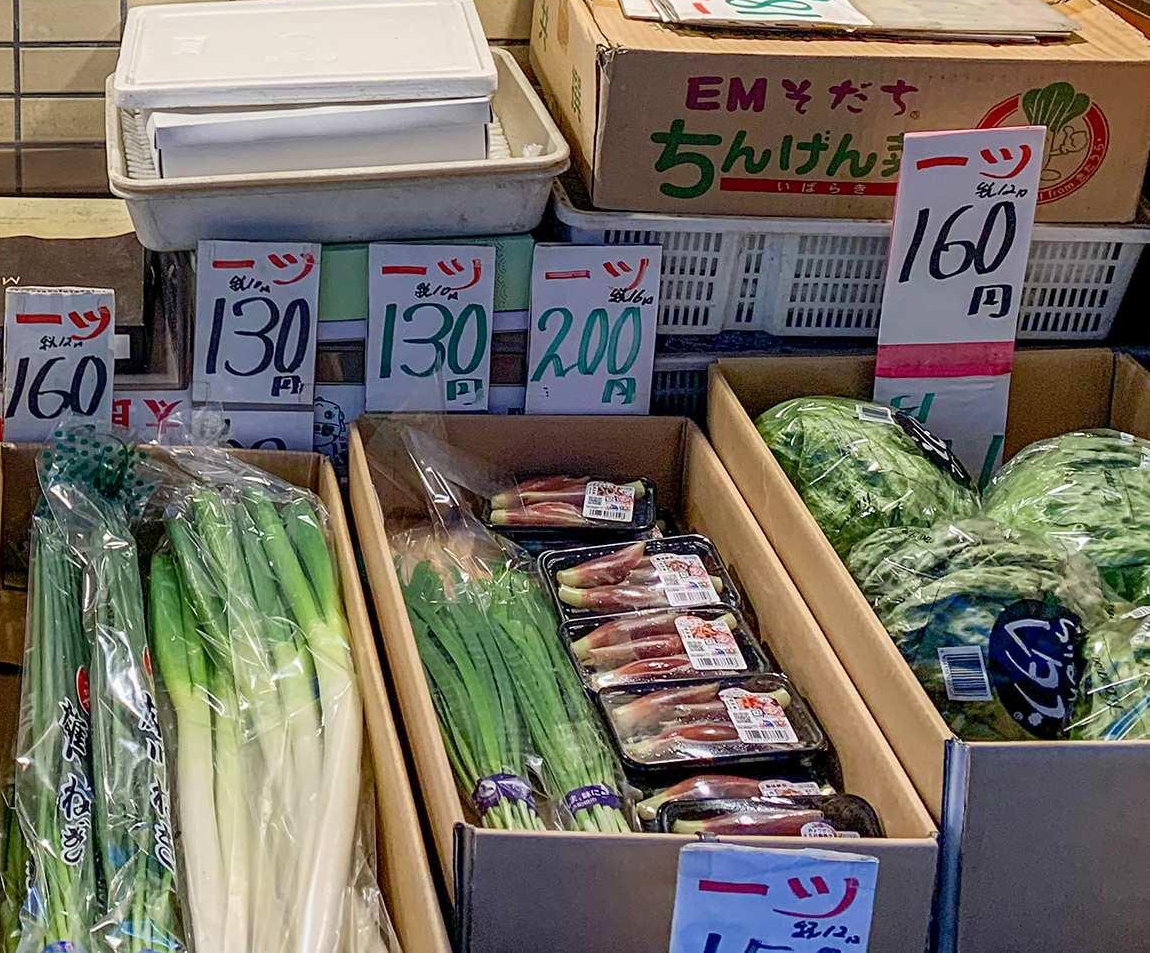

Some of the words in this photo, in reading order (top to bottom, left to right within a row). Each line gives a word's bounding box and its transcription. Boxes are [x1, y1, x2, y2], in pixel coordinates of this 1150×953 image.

[777, 181, 868, 195] いばらき
[898, 201, 1017, 283] 160
[967, 284, 1013, 319] 円
[205, 296, 310, 377] 130
[379, 302, 487, 379] 130
[530, 305, 642, 382] 200
[5, 355, 108, 419] 160
[270, 375, 304, 397] 円
[602, 377, 636, 404] 円
